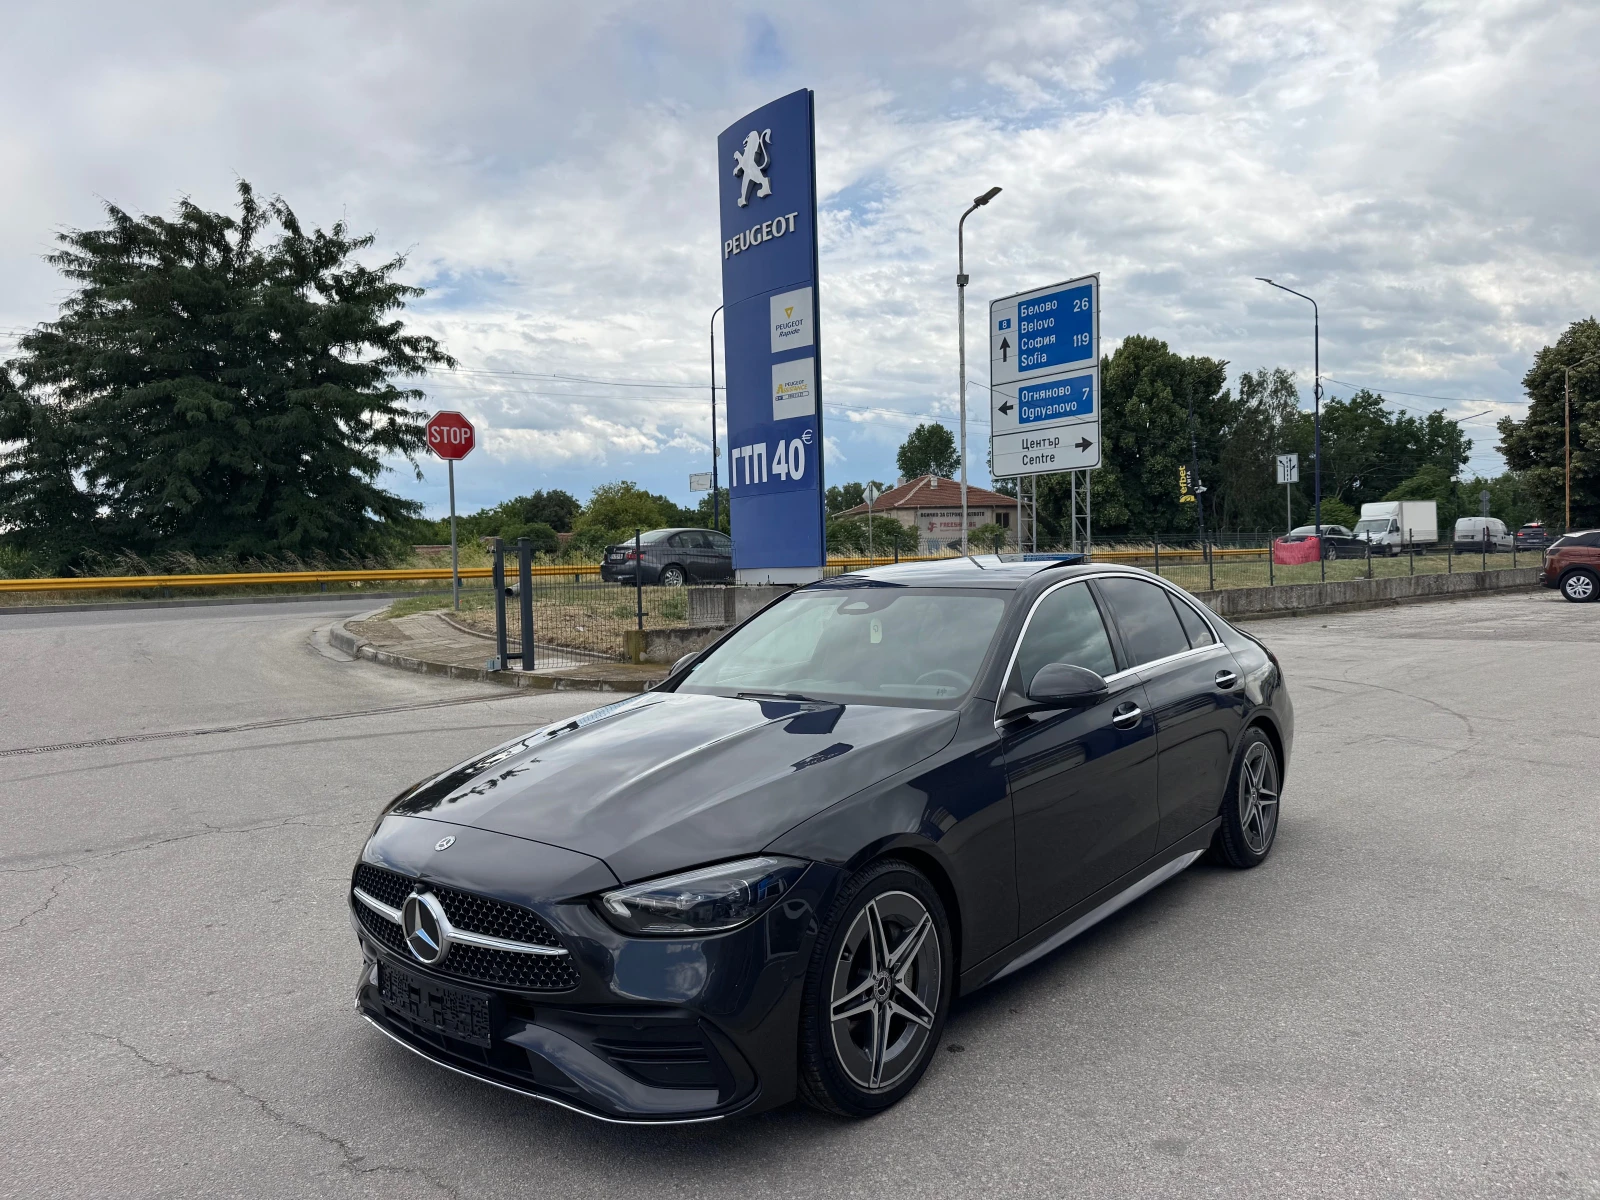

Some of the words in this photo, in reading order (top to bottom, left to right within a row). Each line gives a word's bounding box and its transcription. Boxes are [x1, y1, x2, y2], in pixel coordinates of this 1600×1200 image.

[724, 211, 798, 259] PEUGEOT
[1021, 300, 1058, 318] Белово
[1073, 298, 1089, 313] 26
[775, 319, 804, 331] PEUGEOT
[778, 328, 801, 338] Rapide
[1002, 320, 1007, 329] 8
[1021, 317, 1055, 334] Belovo
[1021, 334, 1056, 350] София
[1073, 332, 1089, 347] 119
[1021, 352, 1047, 367] Sofia
[1021, 385, 1071, 402] Огняново
[1082, 387, 1090, 400] 7
[1021, 400, 1077, 420] Ognyanovo
[430, 425, 471, 445] STOP
[1021, 436, 1060, 451] Център
[731, 442, 768, 487] ГТП
[1022, 452, 1056, 466] Centre
[1179, 465, 1187, 494] efbet
